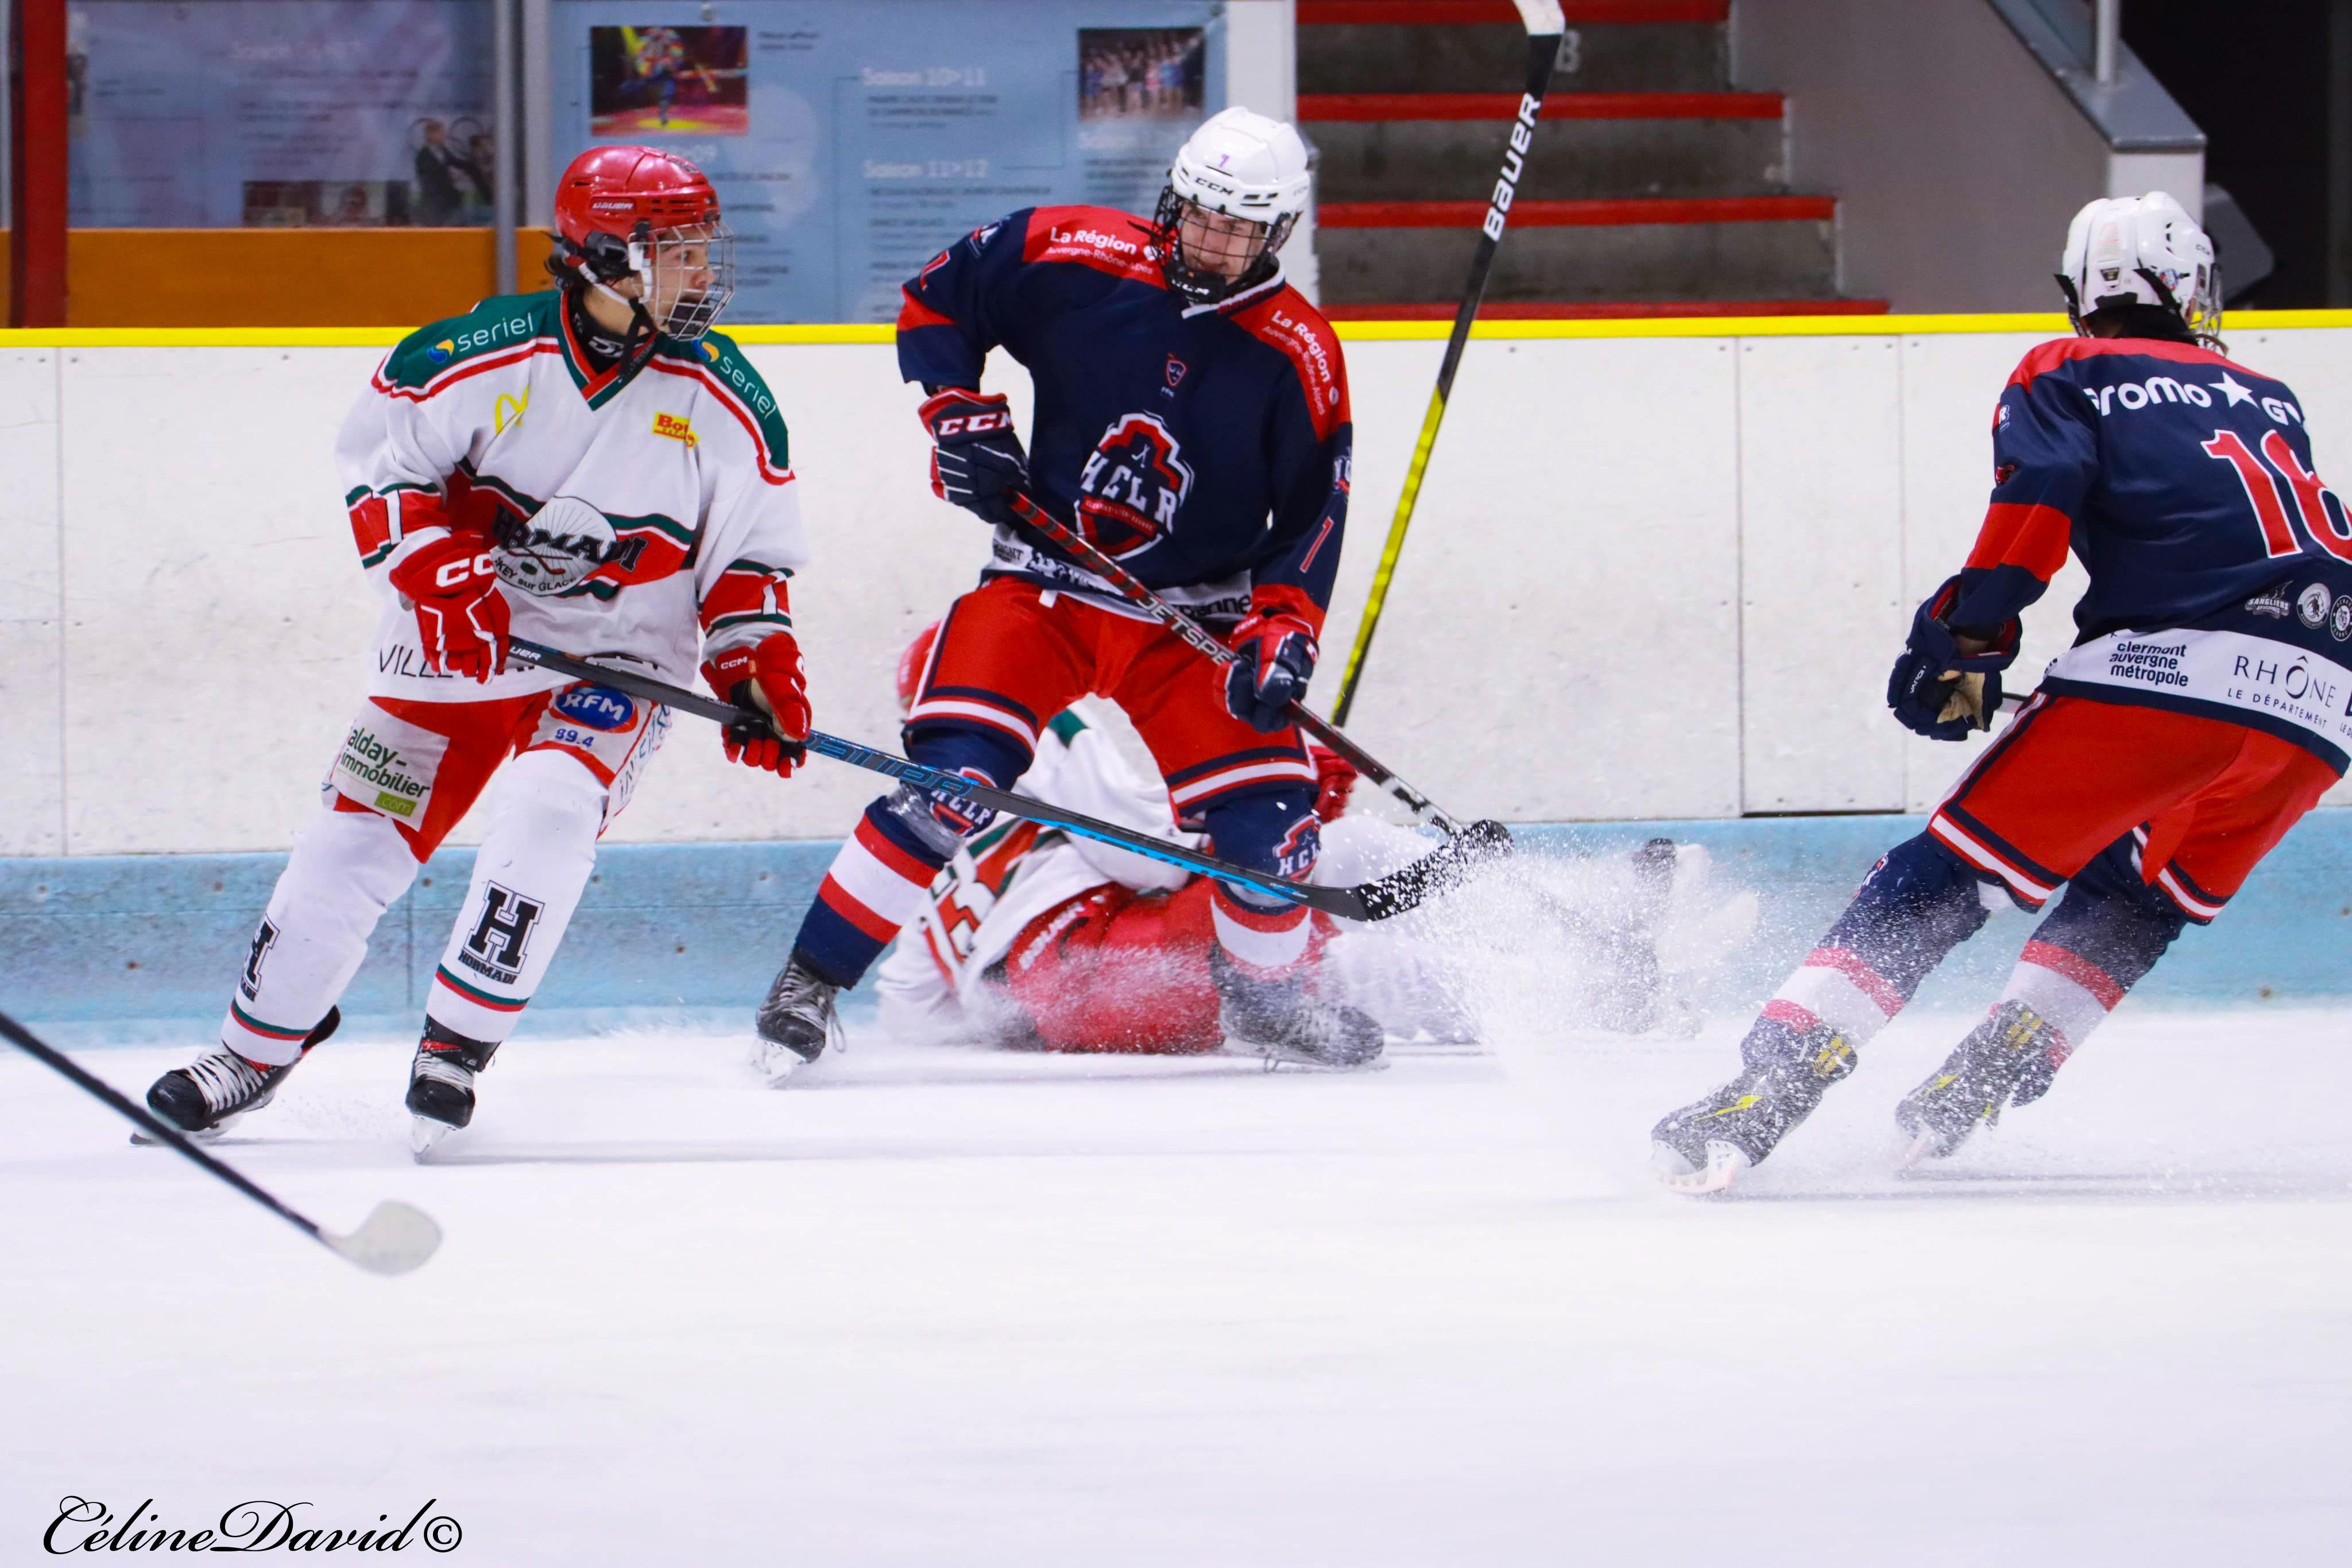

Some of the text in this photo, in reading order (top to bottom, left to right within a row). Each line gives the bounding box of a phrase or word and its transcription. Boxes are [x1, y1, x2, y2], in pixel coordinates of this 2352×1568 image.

[1483, 92, 1541, 242] BAUER
[1194, 177, 1235, 196] CCM
[1050, 227, 1138, 255] La Région
[458, 312, 533, 352] seriel
[1271, 310, 1331, 383] La Région
[719, 356, 777, 420] seriel
[1080, 450, 1177, 535] HCLR
[2200, 429, 2352, 564] 16
[436, 553, 494, 587] CC
[494, 557, 517, 579] KEY
[518, 578, 535, 591] sur
[1136, 597, 1232, 666] JETSPE
[2117, 641, 2187, 657] clermont
[380, 644, 453, 678] VILL
[509, 646, 541, 661] UER
[721, 656, 748, 670] CCM
[2109, 652, 2179, 669] auvergne
[2110, 664, 2189, 687] métropole
[2233, 655, 2336, 708] RHÔNE
[561, 694, 625, 721] RFM
[2227, 688, 2243, 699] LE
[2253, 694, 2327, 729] DÉPARTEMENT
[341, 749, 431, 798] immobilier
[1276, 843, 1318, 877] HCL
[463, 880, 546, 974] H
[458, 948, 518, 985] HORMADI
